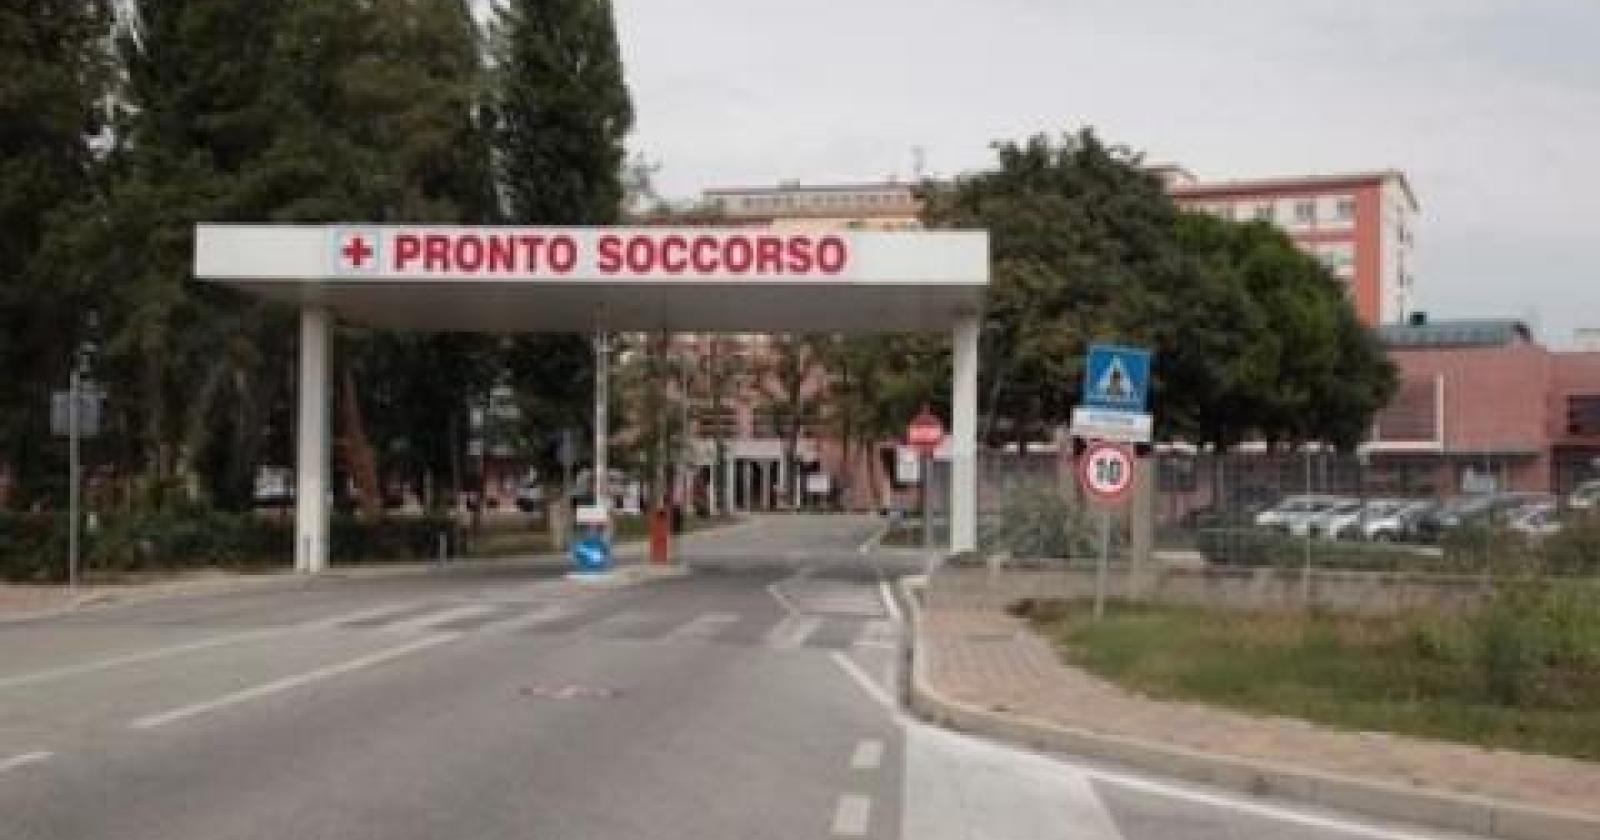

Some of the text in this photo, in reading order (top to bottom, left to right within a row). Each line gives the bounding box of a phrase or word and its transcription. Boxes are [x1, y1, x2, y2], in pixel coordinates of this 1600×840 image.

[394, 235, 848, 274] PRONTO SOCCORSO
[1096, 457, 1121, 485] 10
